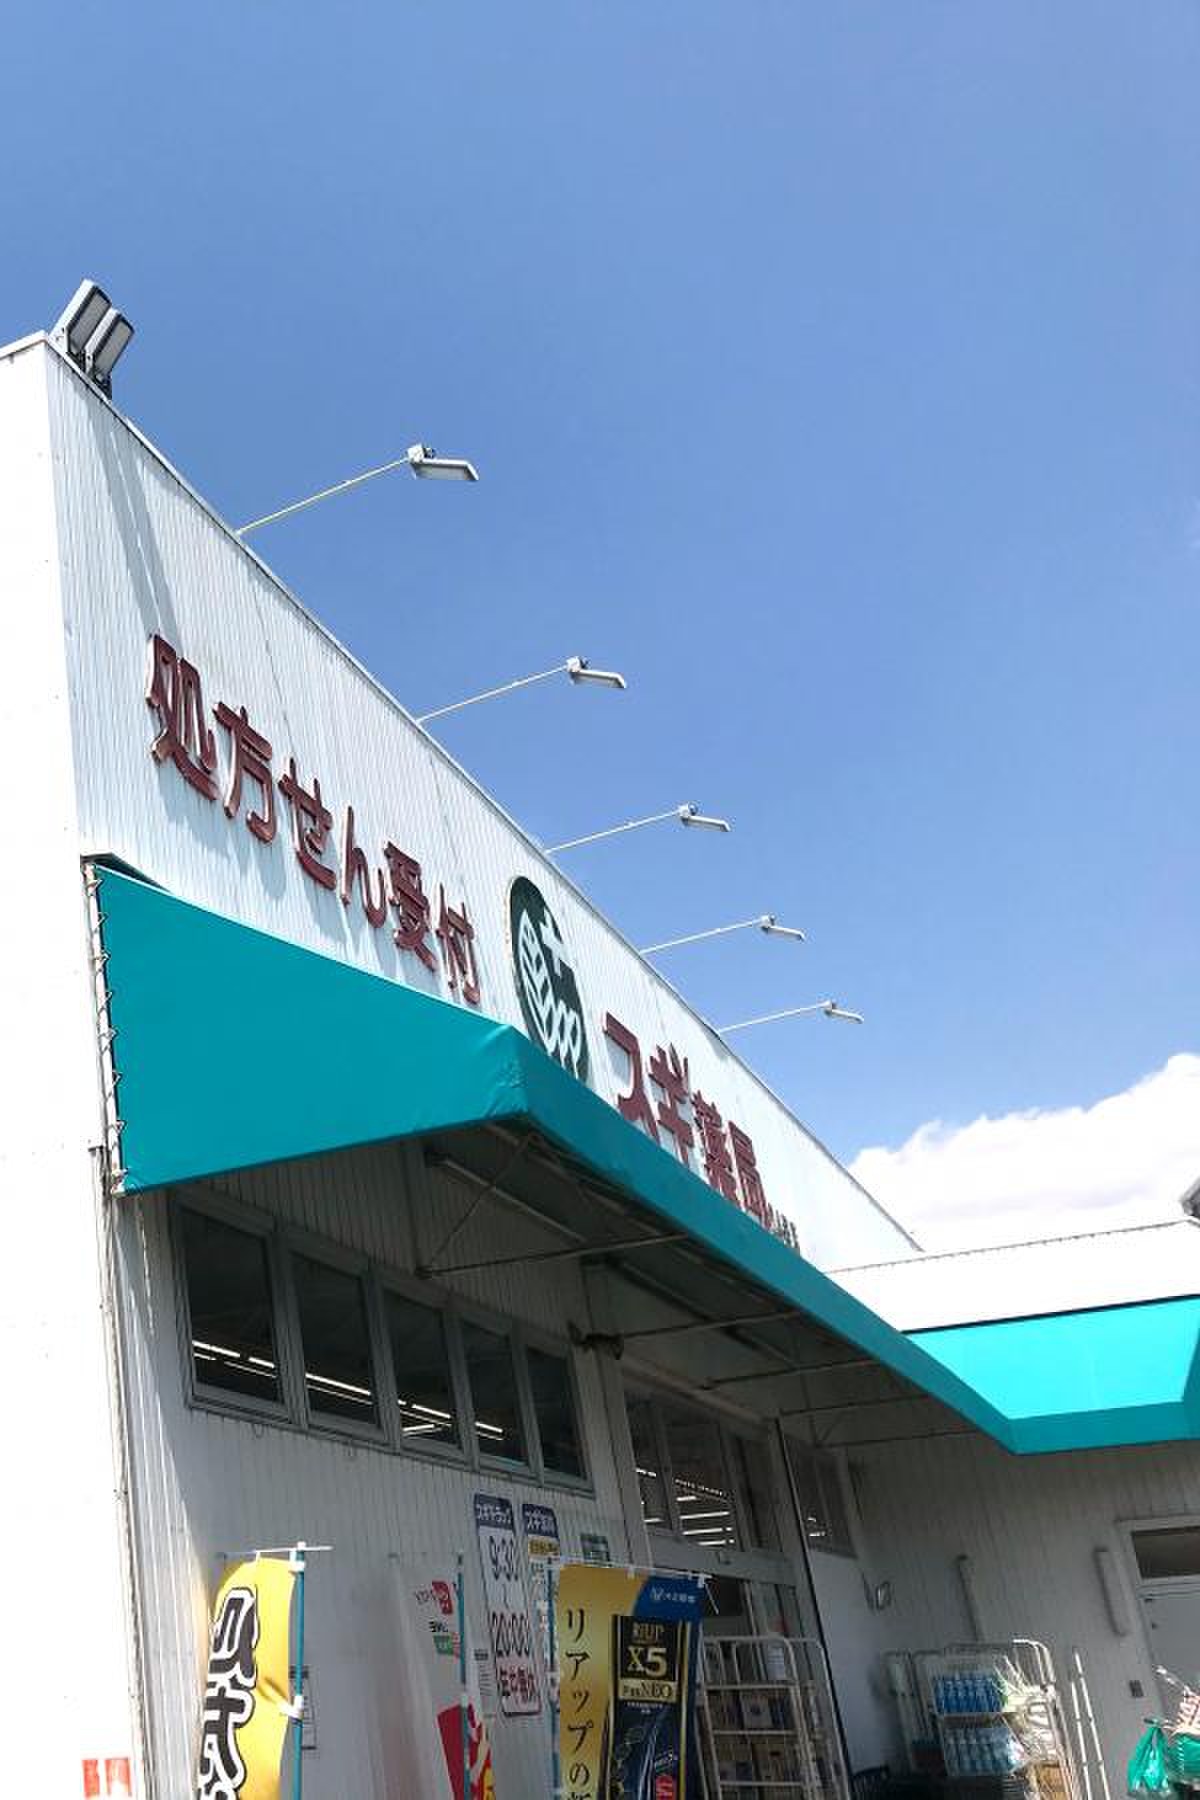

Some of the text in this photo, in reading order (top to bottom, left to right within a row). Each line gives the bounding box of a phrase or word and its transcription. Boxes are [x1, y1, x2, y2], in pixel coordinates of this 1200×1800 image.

[146, 634, 481, 1005] 処方せん受付
[603, 1011, 770, 1231] スギ薬局
[627, 1646, 668, 1677] X5
